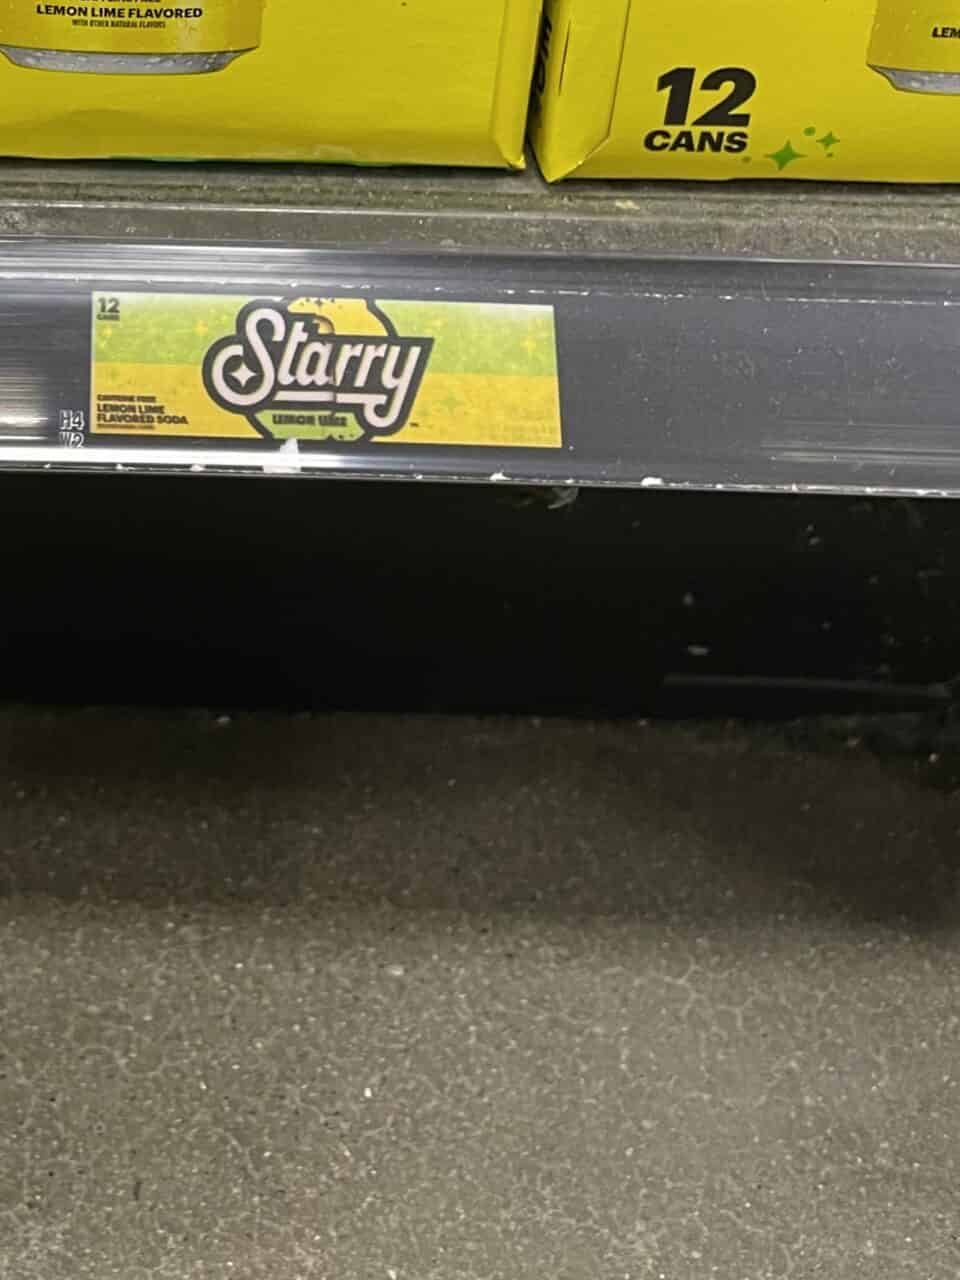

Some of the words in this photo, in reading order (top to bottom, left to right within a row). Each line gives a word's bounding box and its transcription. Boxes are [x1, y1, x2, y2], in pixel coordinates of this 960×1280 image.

[36, 4, 88, 17] LEMON
[91, 6, 126, 19] LIME
[128, 7, 203, 19] FLAVORED
[657, 67, 756, 127] 12
[643, 130, 748, 153] CANS
[97, 297, 120, 313] 12
[212, 308, 421, 428] Starry
